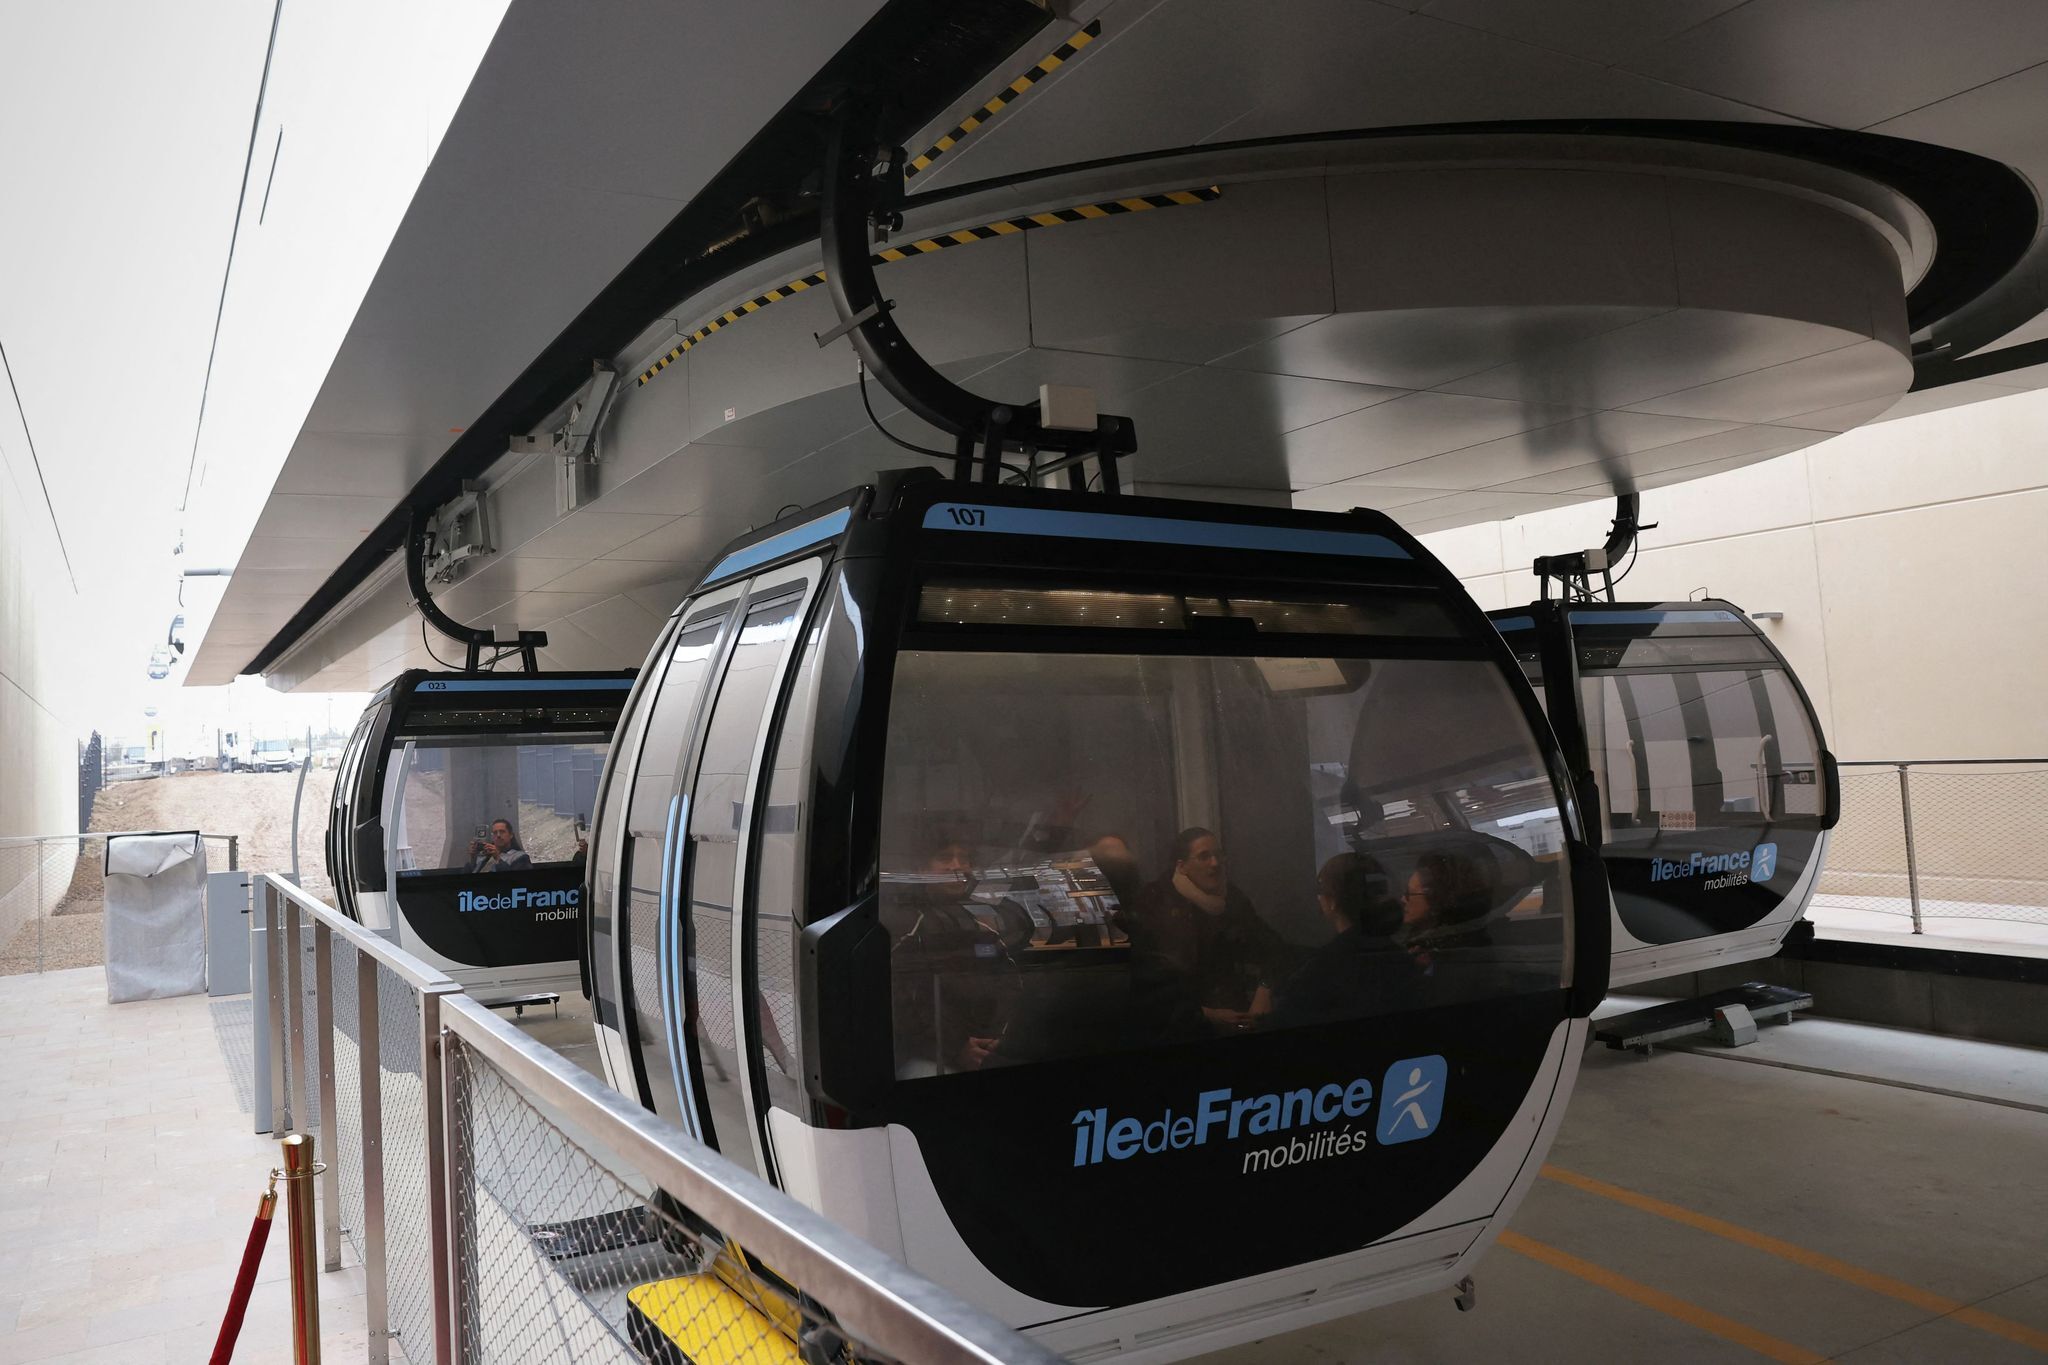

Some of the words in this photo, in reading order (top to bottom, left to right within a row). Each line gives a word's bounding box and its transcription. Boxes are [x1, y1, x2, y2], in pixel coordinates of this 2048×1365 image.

[947, 508, 985, 526] 107
[428, 682, 447, 690] 023
[1651, 851, 1750, 882] îledeFrance
[1703, 871, 1748, 891] mobilités
[458, 888, 579, 912] îledeFranc
[535, 908, 579, 921] mobilit
[1072, 1078, 1373, 1167] îledeFrance
[1242, 1125, 1367, 1174] mobilités
